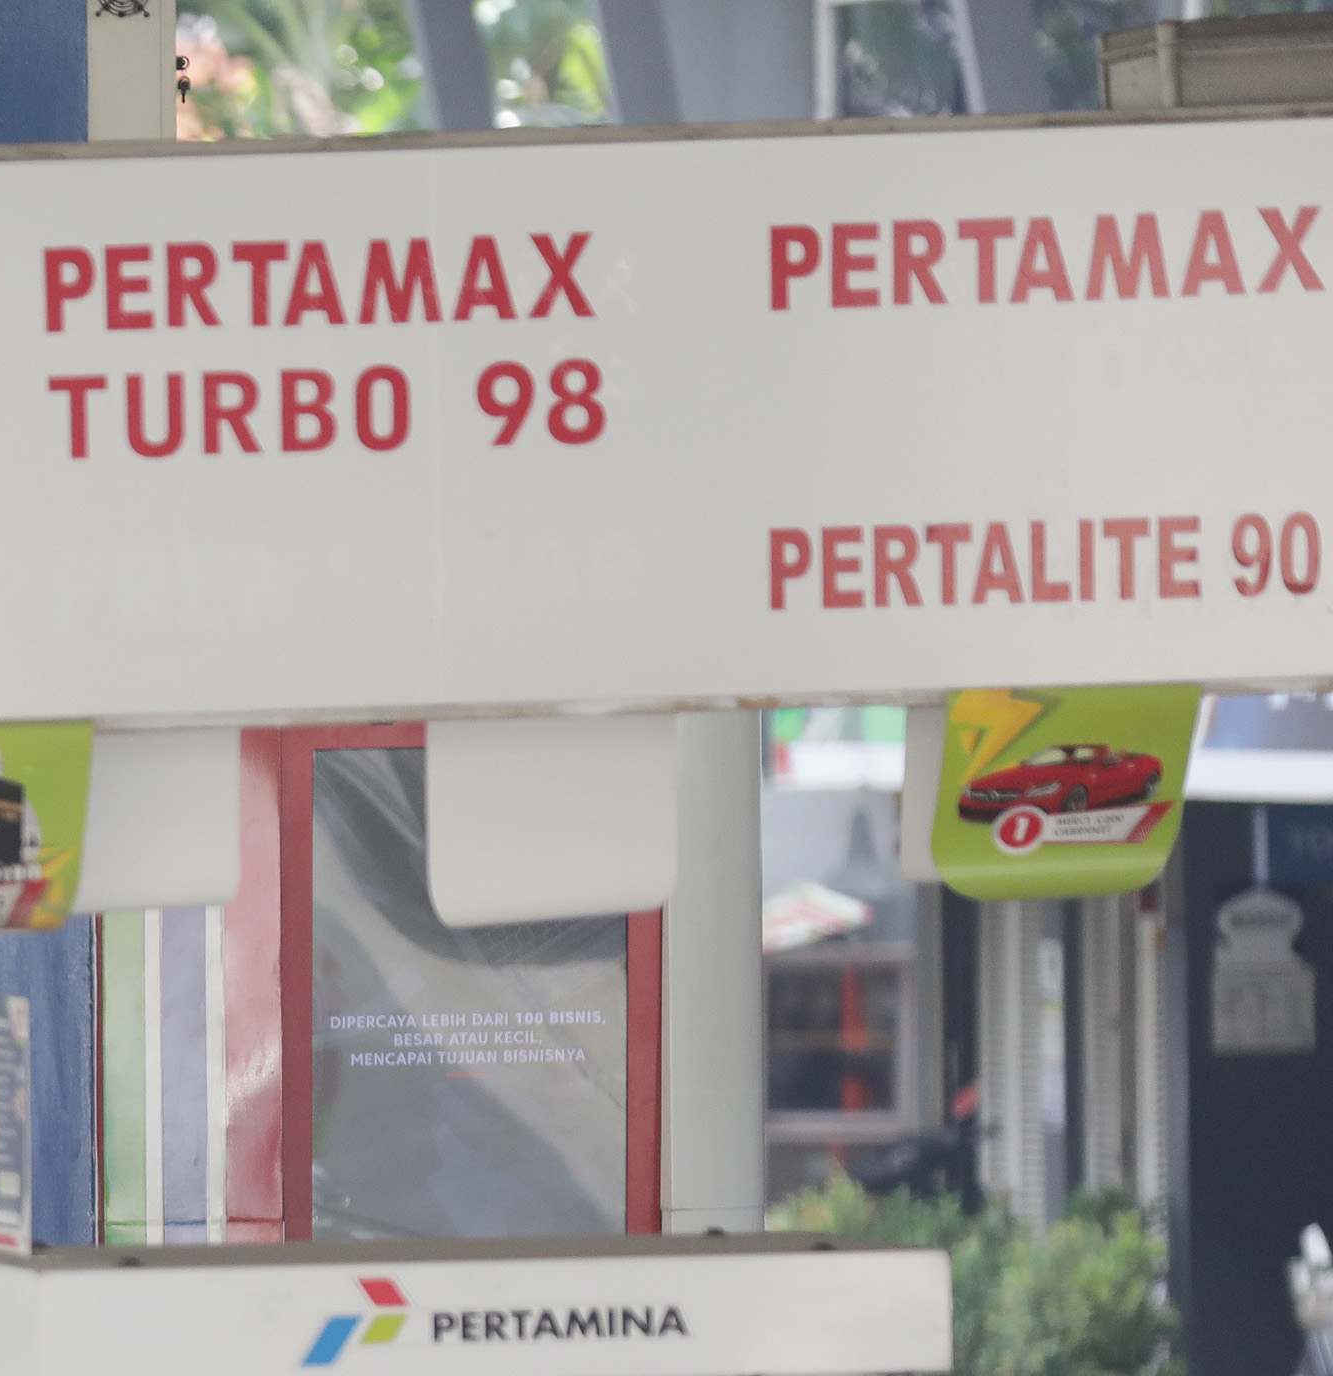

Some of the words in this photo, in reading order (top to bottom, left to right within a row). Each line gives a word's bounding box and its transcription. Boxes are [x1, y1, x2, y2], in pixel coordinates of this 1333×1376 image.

[41, 230, 597, 334] PERTAMAX
[767, 204, 1326, 312] PERTAMAX
[47, 362, 412, 460] TURBO
[475, 357, 609, 447] 98
[767, 515, 1202, 611] PERTALITE
[1230, 511, 1324, 599] 90
[329, 1013, 417, 1031] DIPERCAYA
[422, 1012, 467, 1028] LEBIH
[472, 1012, 510, 1027] DARI
[515, 1011, 544, 1026] 100
[393, 1031, 444, 1048] BESAR
[448, 1031, 489, 1047] ATAU
[349, 1051, 433, 1068] MENCAPAI
[437, 1050, 498, 1066] TUJUAN
[503, 1047, 587, 1064] BISNISNYA
[429, 1303, 692, 1345] PERTAMINA
